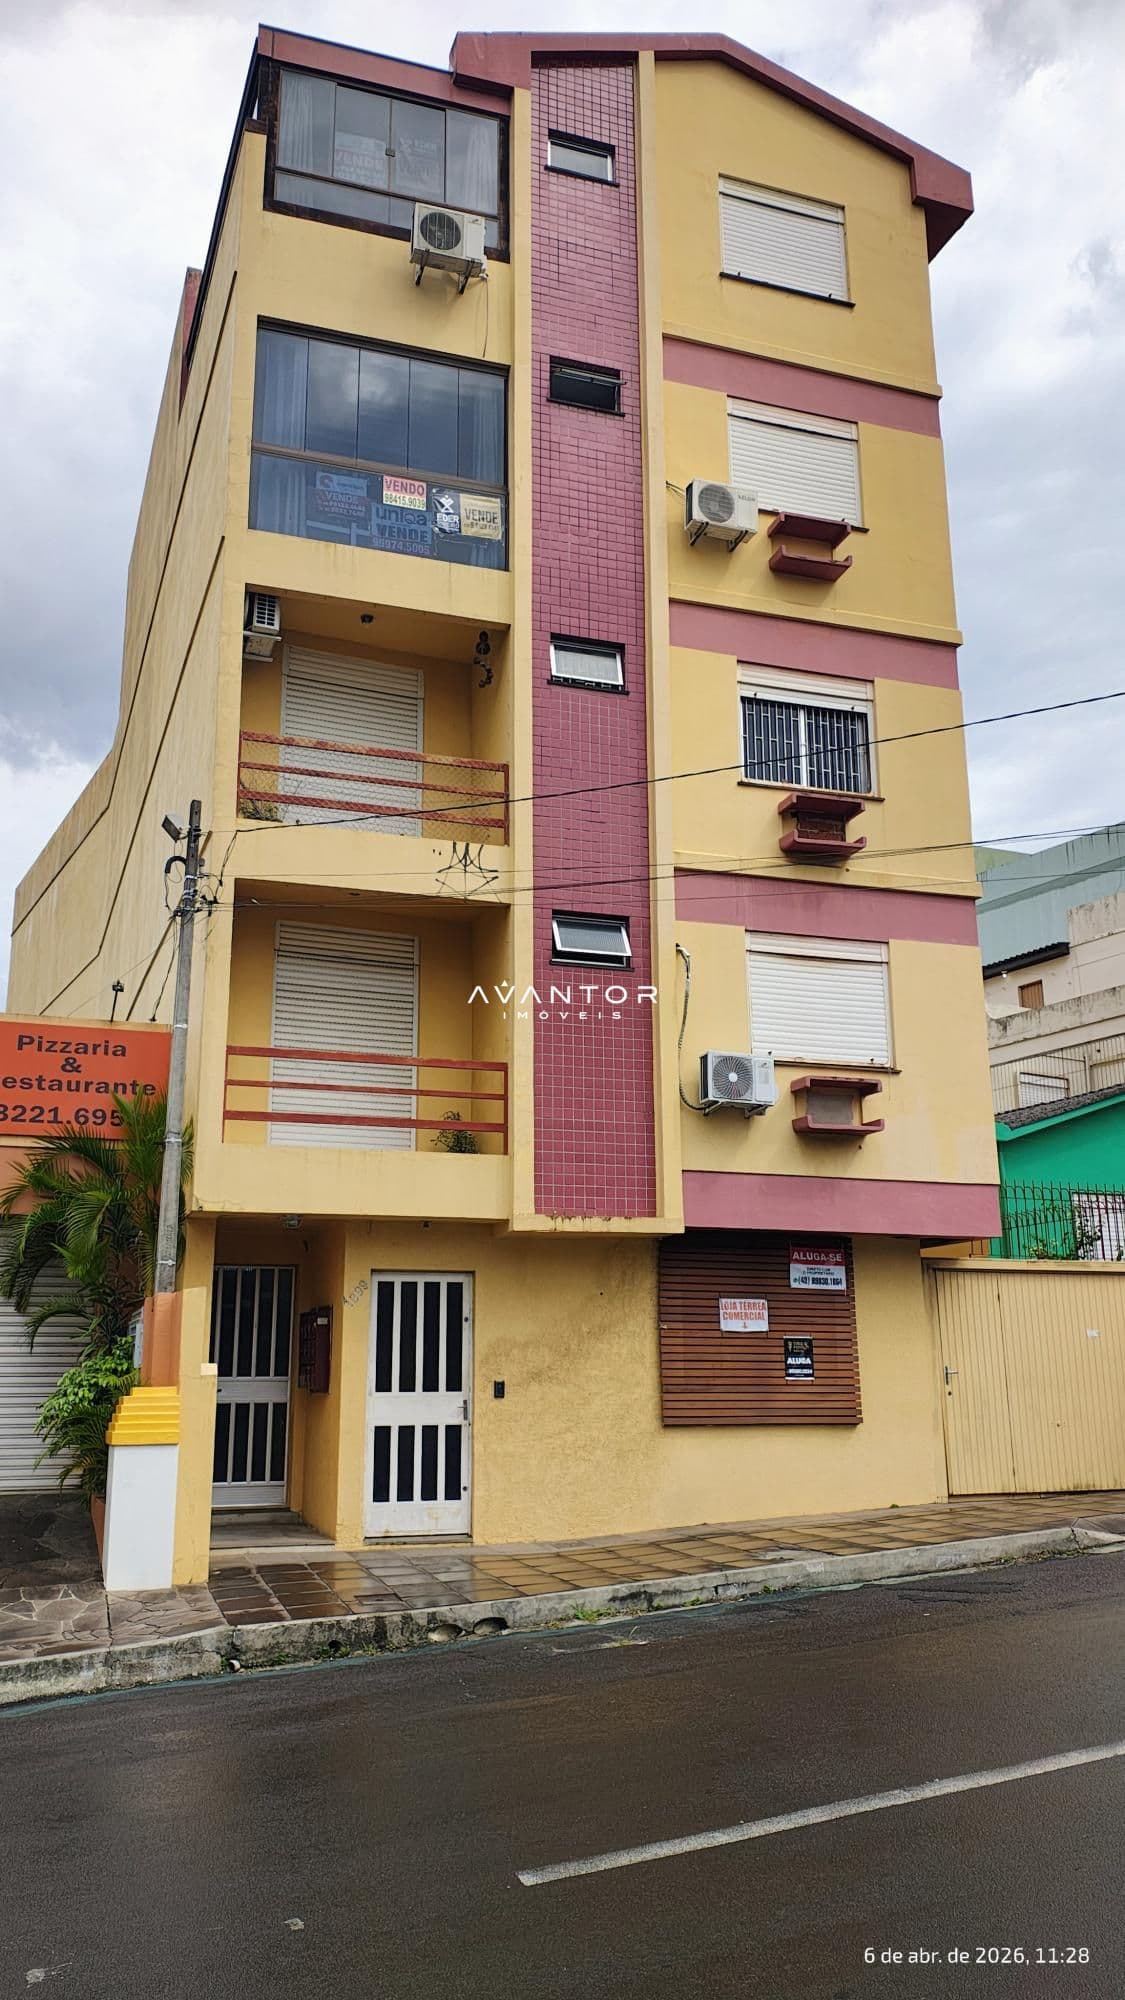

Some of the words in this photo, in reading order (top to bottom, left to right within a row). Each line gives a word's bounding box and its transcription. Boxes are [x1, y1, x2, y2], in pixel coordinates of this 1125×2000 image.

[385, 478, 425, 496] VENDO
[436, 512, 460, 524] EDER
[464, 507, 499, 524] VENDE
[376, 523, 429, 543] VENDE
[17, 1034, 127, 1057] Pizzaria
[61, 1056, 82, 1073] &
[2, 1075, 157, 1096] estaurante
[0, 1104, 125, 1127] 3221.695
[792, 1251, 843, 1262] ALUGA-SE
[721, 1302, 738, 1311] LOJA
[722, 1311, 765, 1321] COMERCIAL
